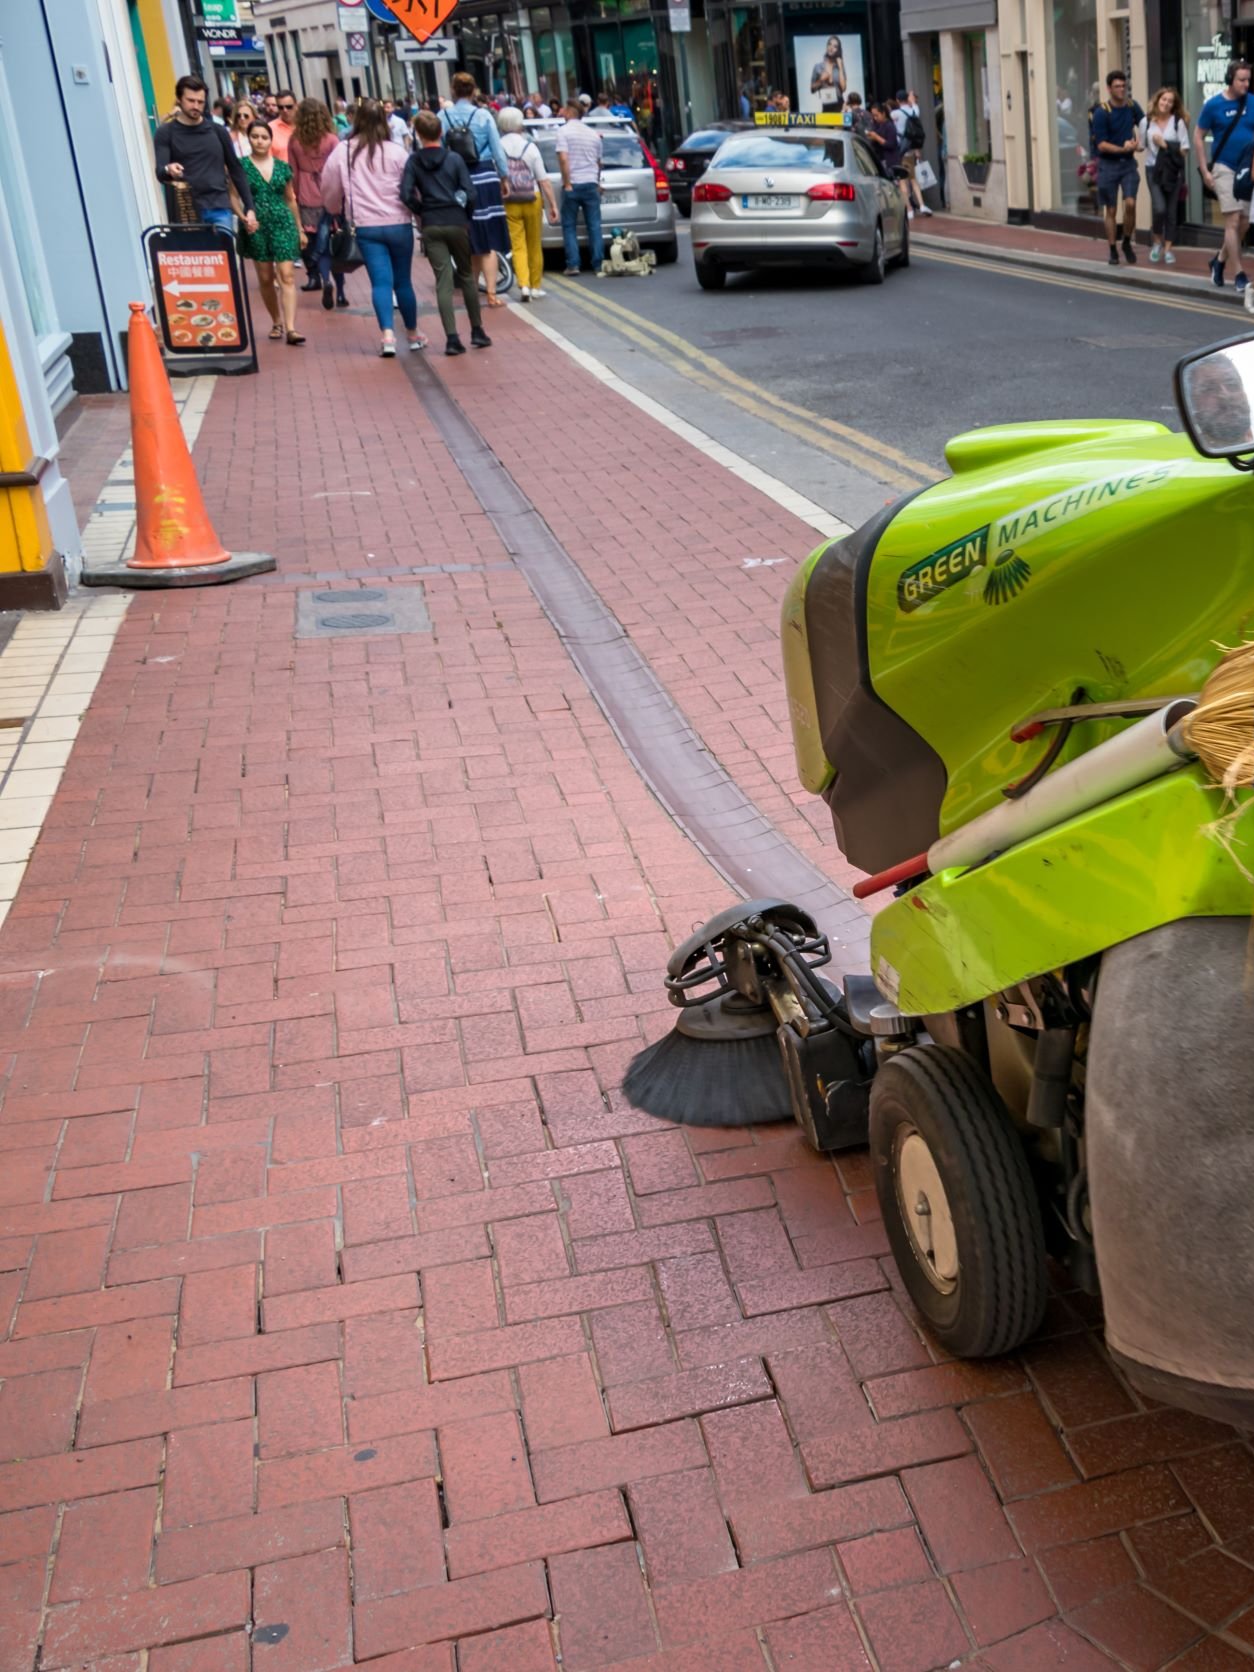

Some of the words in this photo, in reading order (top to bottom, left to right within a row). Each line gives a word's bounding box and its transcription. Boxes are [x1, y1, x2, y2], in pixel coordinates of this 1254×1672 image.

[201, 28, 238, 39] WONDR
[789, 113, 815, 125] TAXI
[159, 254, 224, 266] Restaurant
[903, 537, 981, 602] GREEN
[997, 465, 1170, 547] MACHINES
